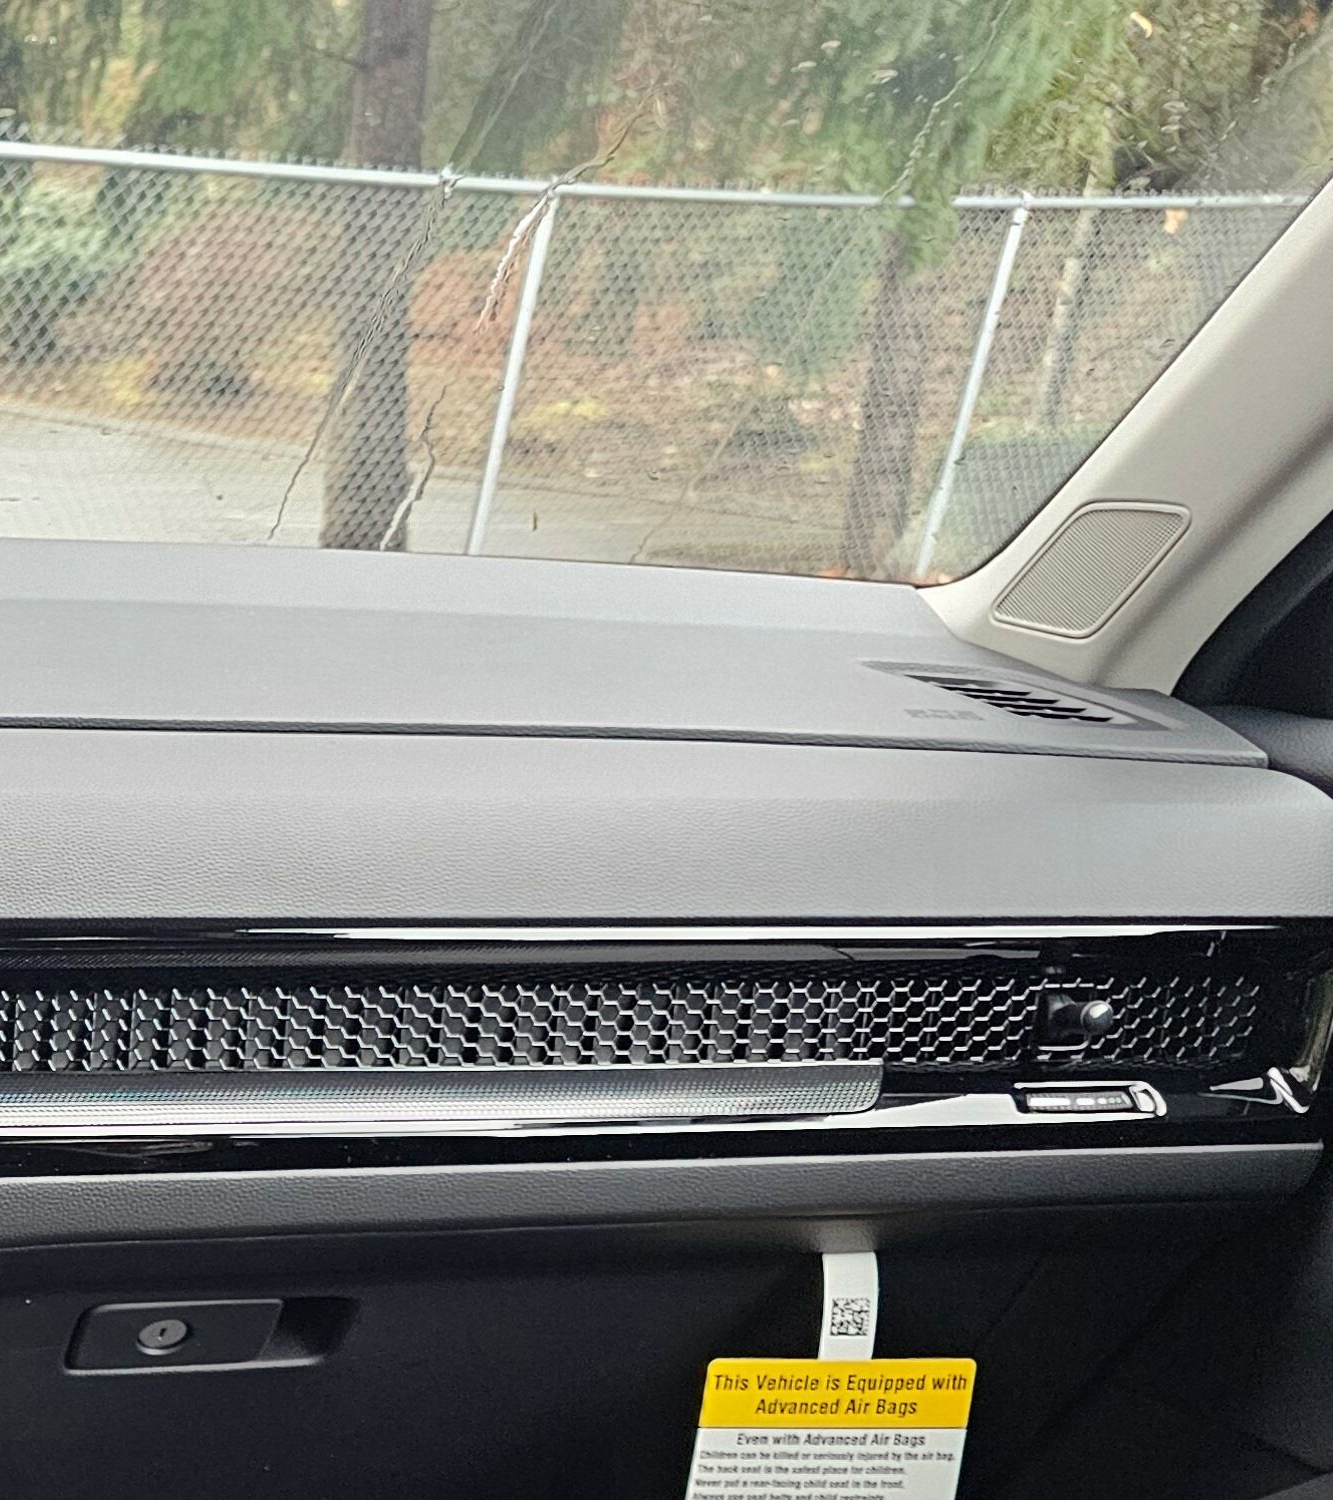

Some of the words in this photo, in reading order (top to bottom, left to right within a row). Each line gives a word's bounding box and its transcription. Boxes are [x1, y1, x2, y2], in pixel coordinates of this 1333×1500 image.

[714, 1374, 749, 1390] This
[756, 1375, 819, 1391] Vehicle
[826, 1375, 840, 1391] is
[845, 1374, 926, 1393] Equipped
[931, 1375, 967, 1390] with
[755, 1398, 840, 1415] Advanced
[845, 1399, 870, 1414] Air
[875, 1398, 918, 1417] Bags
[737, 1433, 769, 1446] Even
[773, 1434, 800, 1445] with
[804, 1433, 868, 1446] Advanced
[871, 1433, 890, 1445] Air
[894, 1433, 926, 1448] Bags
